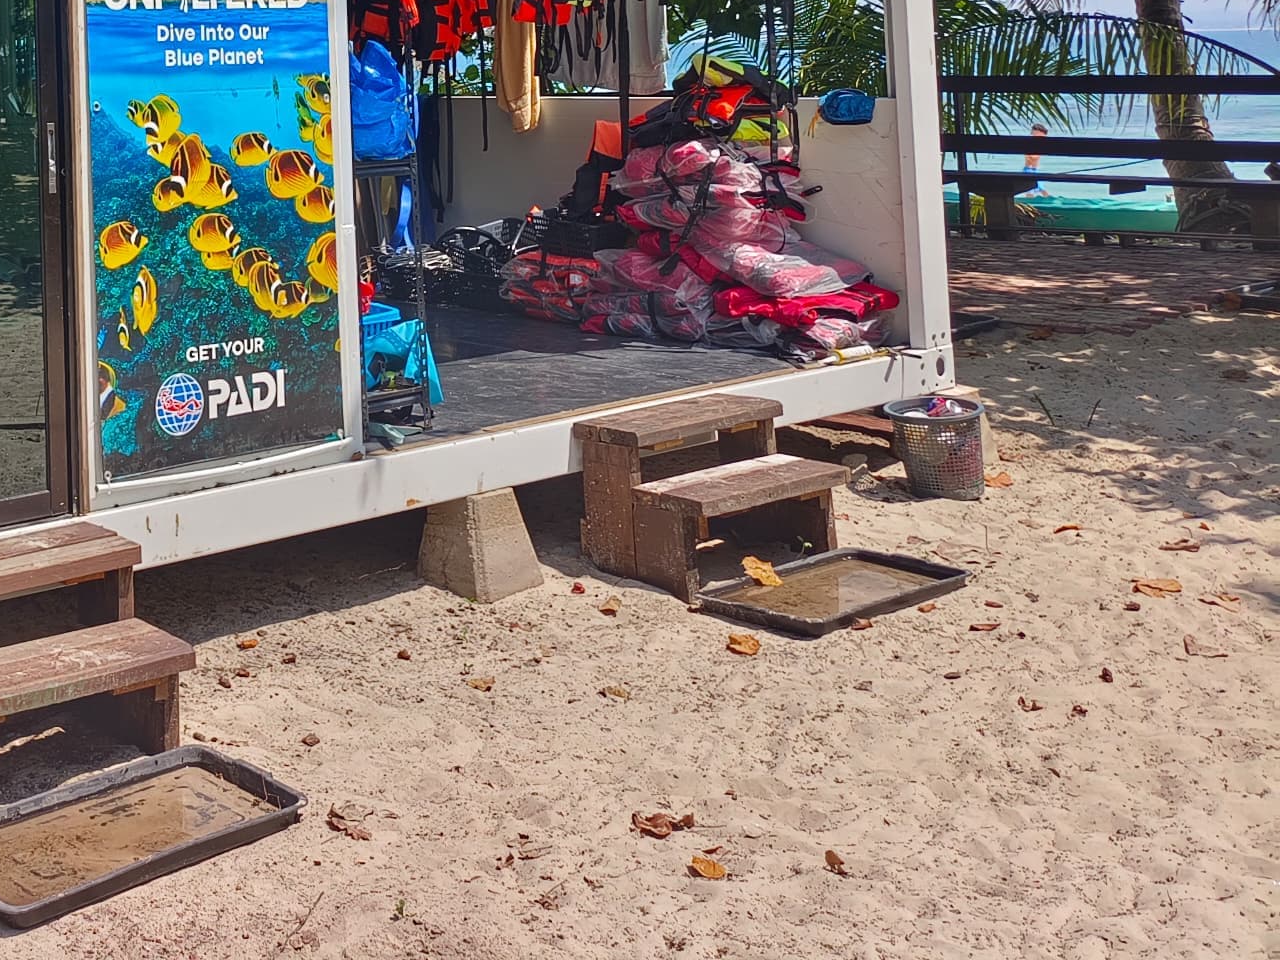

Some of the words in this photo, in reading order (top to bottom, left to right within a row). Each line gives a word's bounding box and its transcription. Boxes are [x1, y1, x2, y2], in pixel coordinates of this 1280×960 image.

[156, 24, 196, 41] Dive
[201, 24, 235, 41] Into
[239, 24, 269, 41] Our
[165, 49, 204, 66] Blue
[209, 48, 264, 66] Planet
[186, 342, 220, 362] GET
[220, 337, 265, 357] YOUR
[208, 369, 287, 419] PADI
